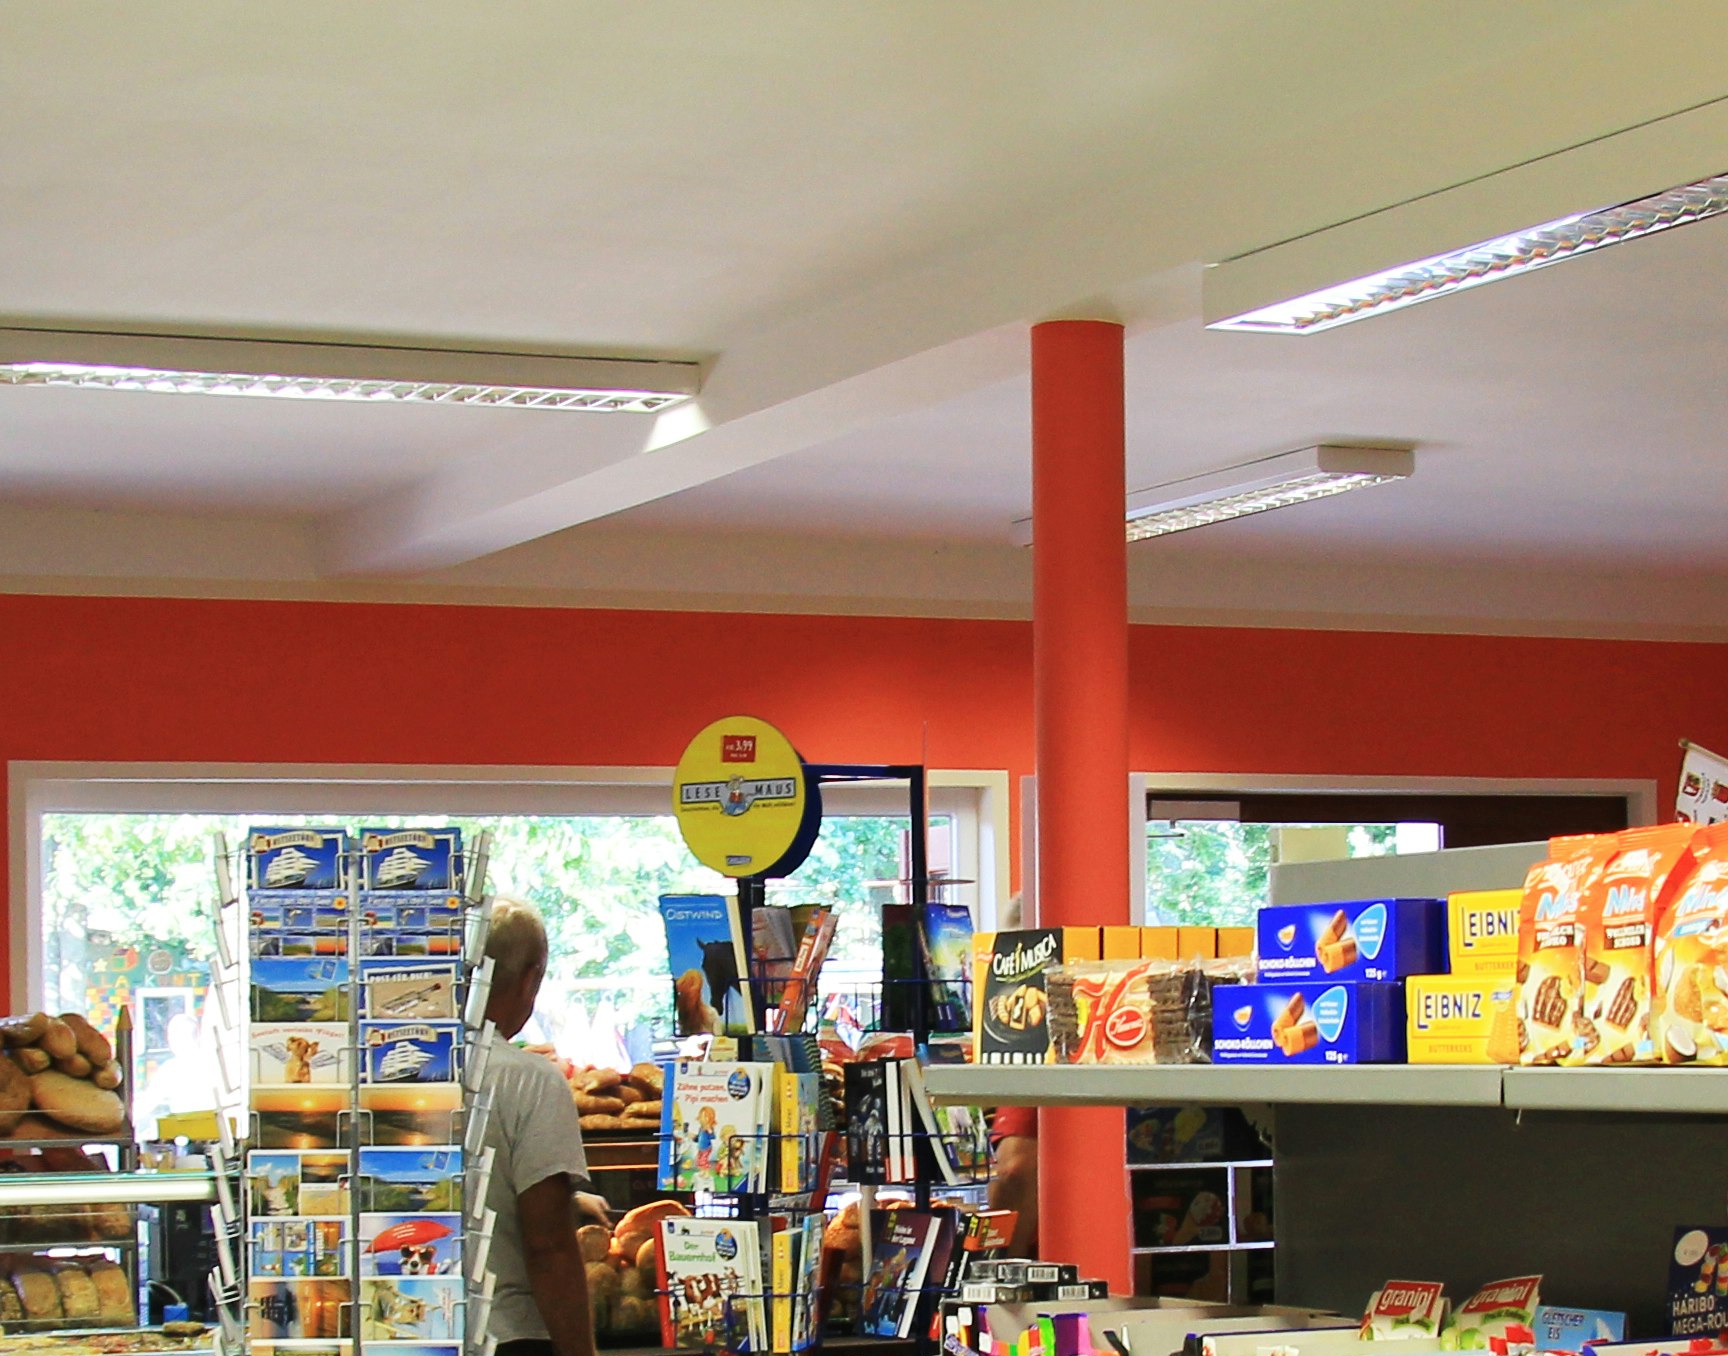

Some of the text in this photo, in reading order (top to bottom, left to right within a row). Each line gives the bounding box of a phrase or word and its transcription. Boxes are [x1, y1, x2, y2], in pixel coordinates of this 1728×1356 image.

[685, 780, 792, 801] LESE MAUS
[1020, 933, 1057, 972] MUSICA
[1418, 988, 1481, 1029] LEIBNIZ
[1380, 1286, 1433, 1311] granini
[1673, 1295, 1715, 1316] HARIBO
[1548, 1327, 1560, 1340] EIS
